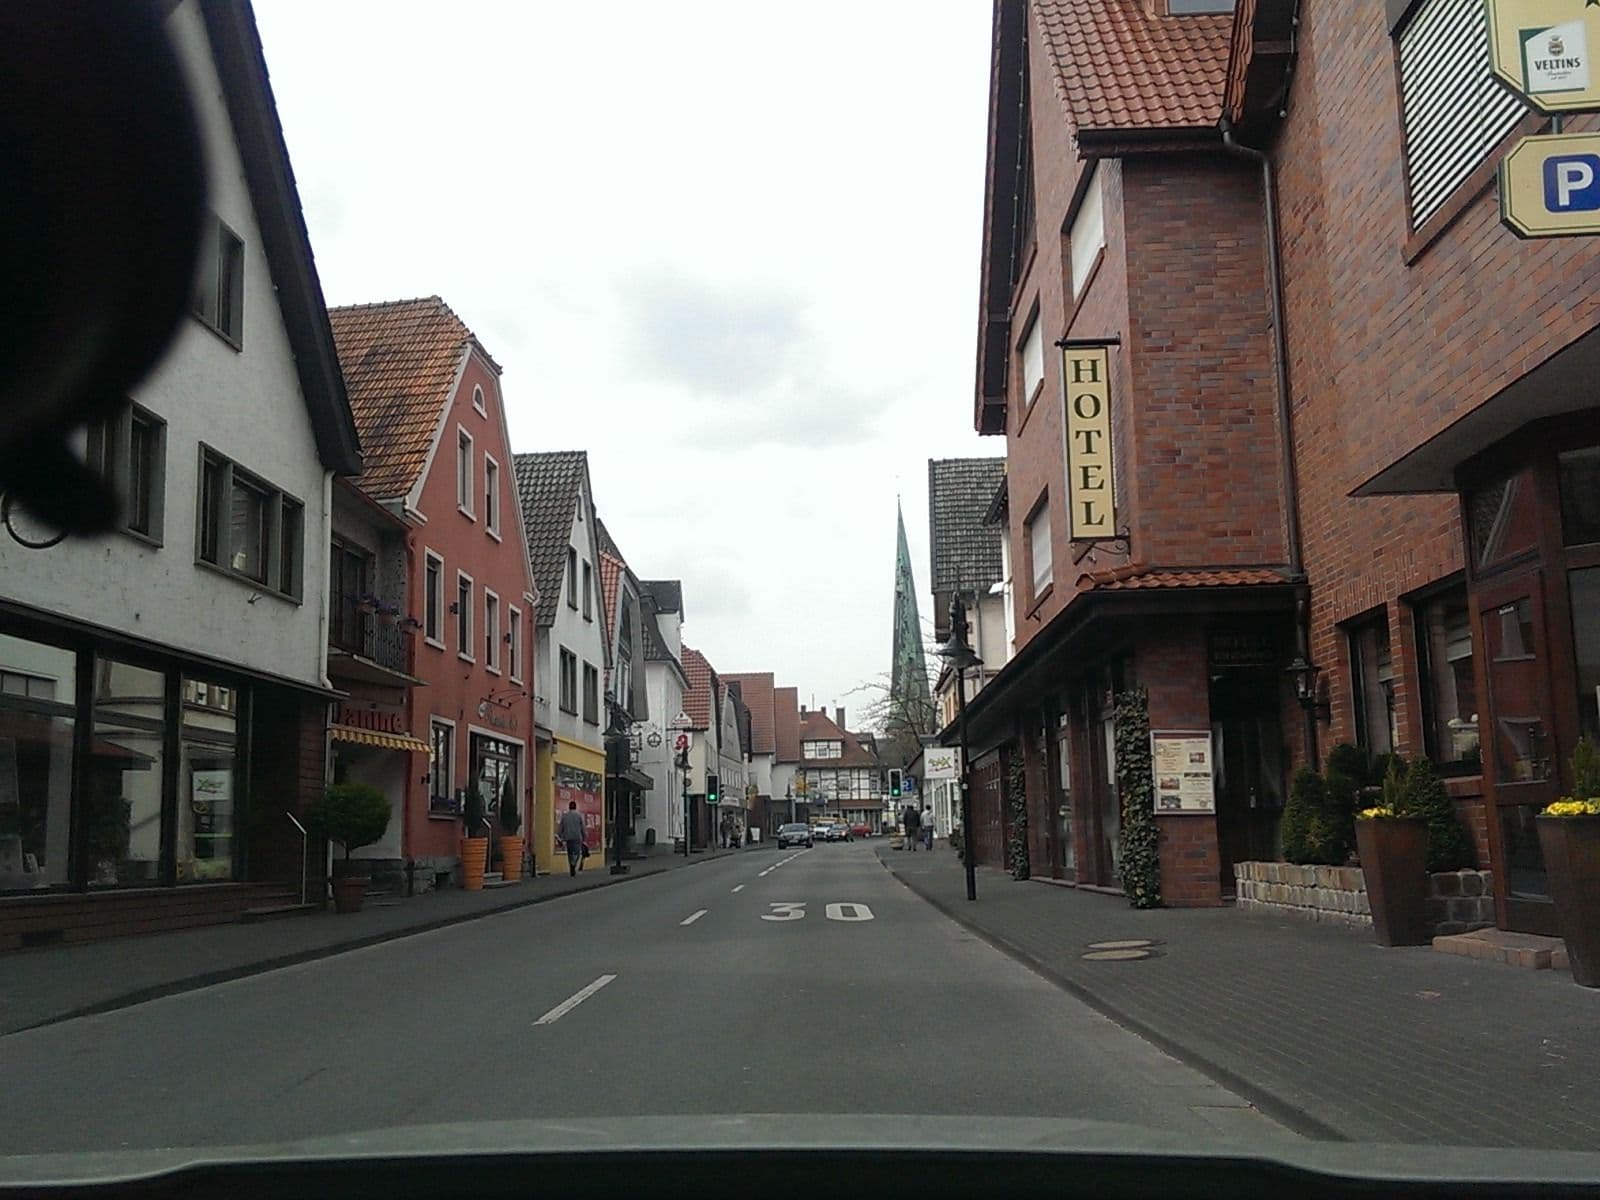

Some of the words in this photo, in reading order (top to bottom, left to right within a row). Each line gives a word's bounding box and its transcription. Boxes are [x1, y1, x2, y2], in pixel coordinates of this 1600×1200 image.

[1534, 57, 1581, 70] VELTINS
[1556, 162, 1594, 206] P
[1070, 358, 1105, 526] HOTEL
[760, 902, 874, 921] 30
